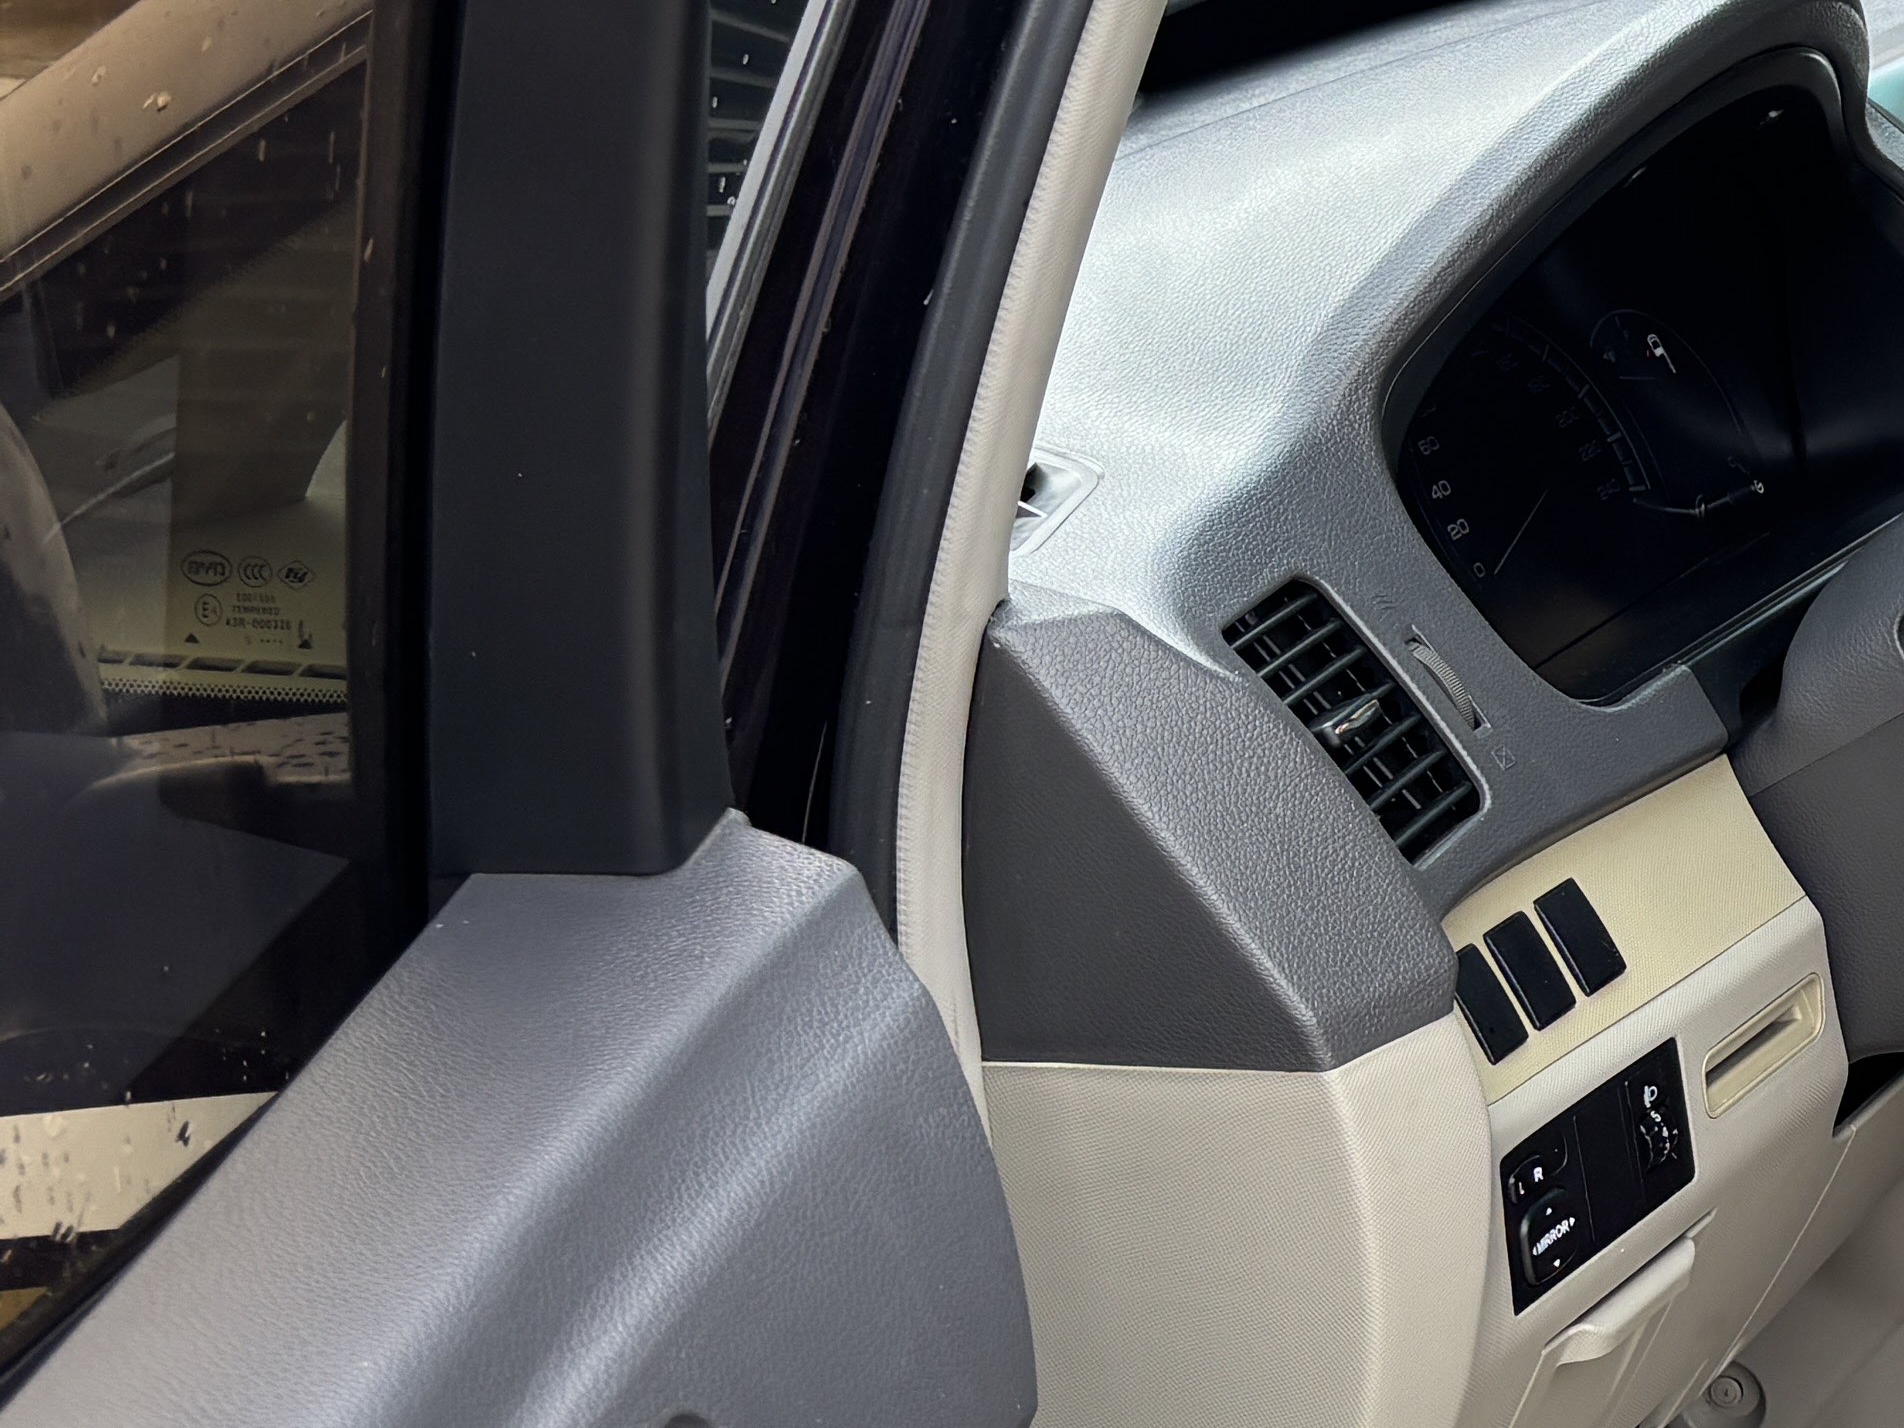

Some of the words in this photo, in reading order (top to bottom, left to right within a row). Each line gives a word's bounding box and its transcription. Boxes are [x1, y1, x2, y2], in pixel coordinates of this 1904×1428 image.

[1431, 480, 1451, 499] 40
[1447, 518, 1469, 540] 20
[1473, 562, 1485, 577] 0
[1533, 1166, 1544, 1183] R
